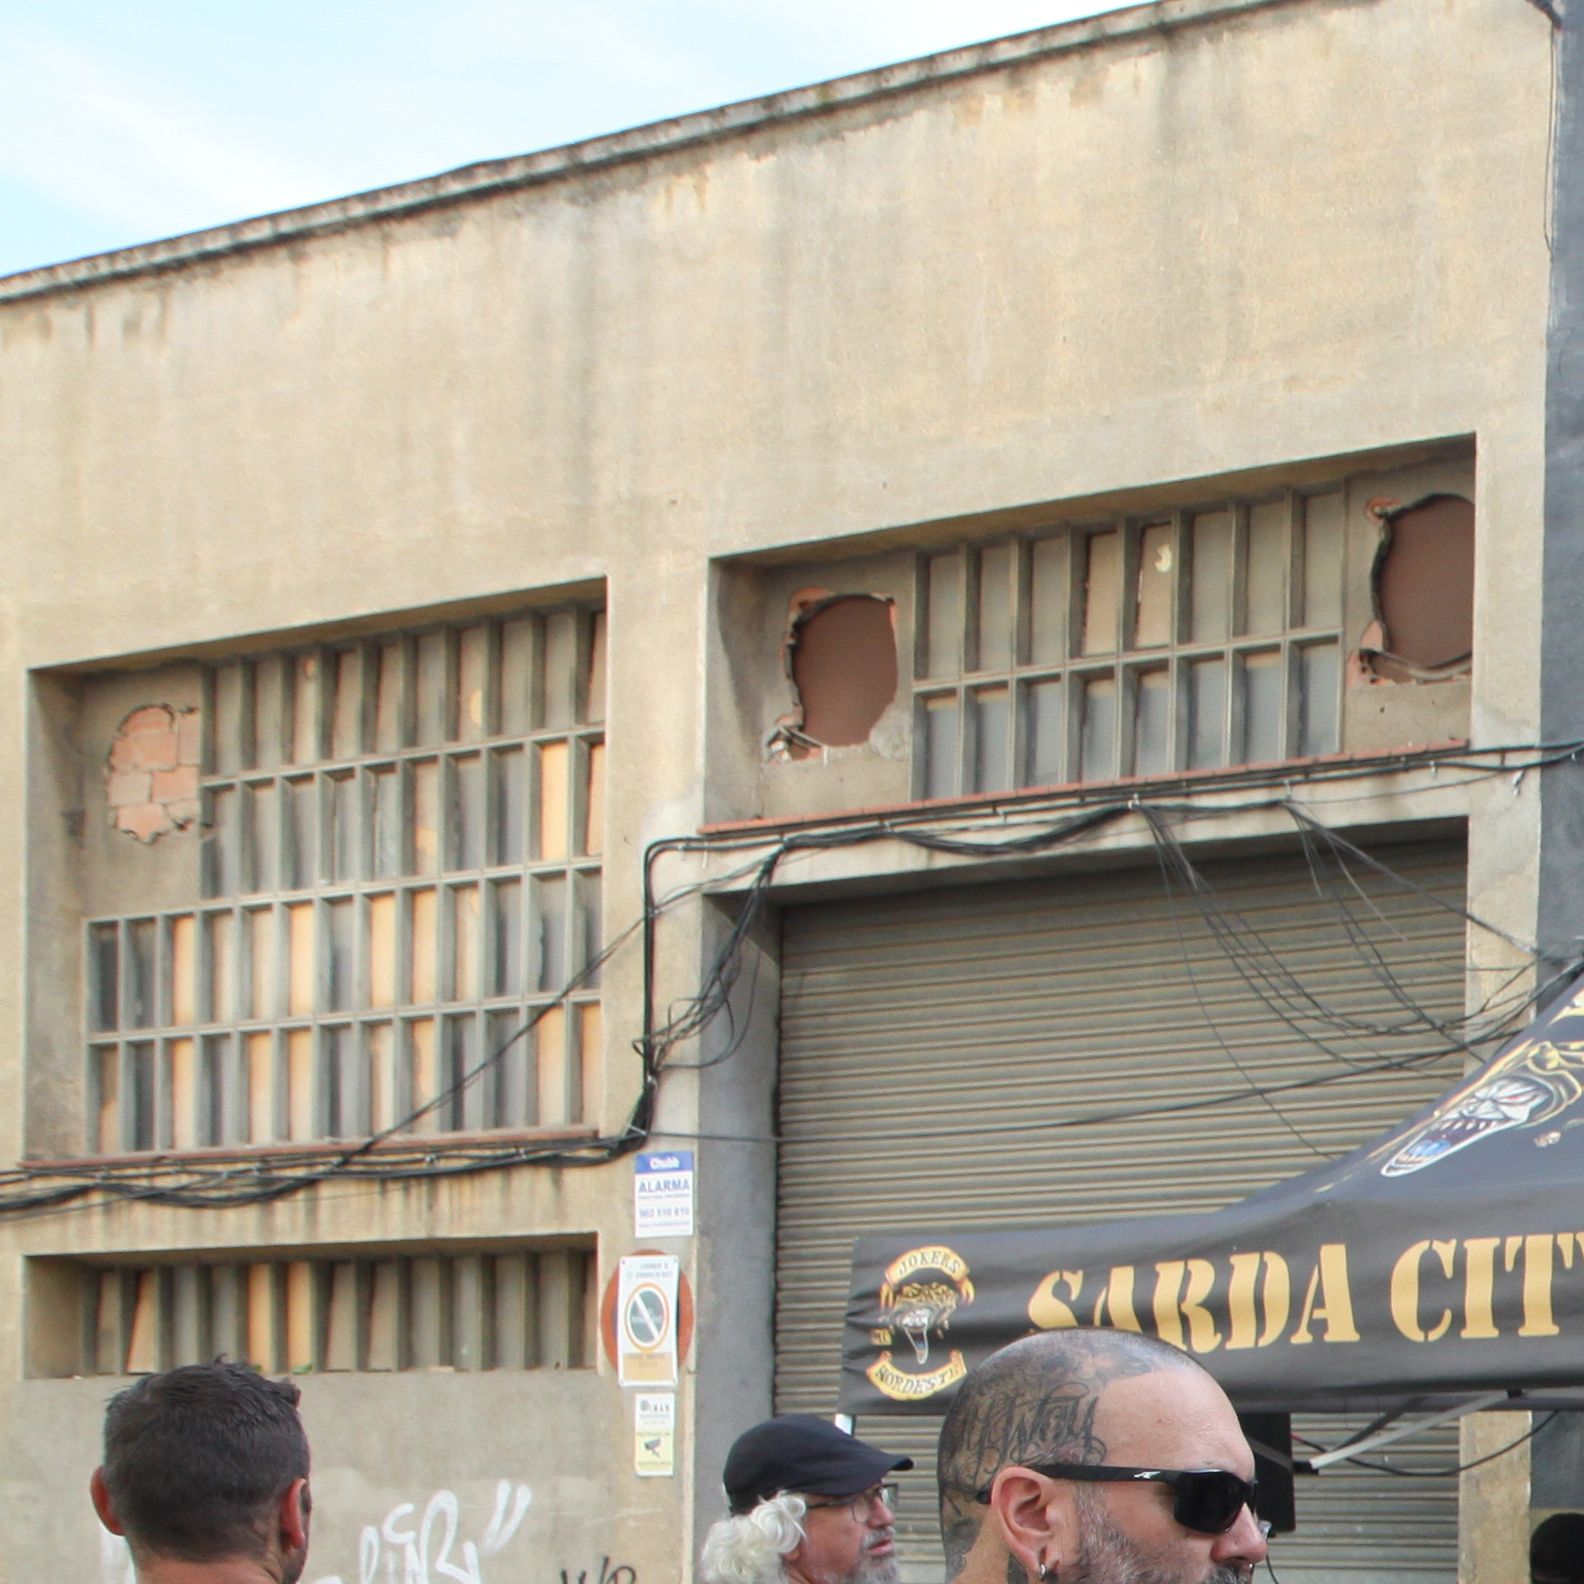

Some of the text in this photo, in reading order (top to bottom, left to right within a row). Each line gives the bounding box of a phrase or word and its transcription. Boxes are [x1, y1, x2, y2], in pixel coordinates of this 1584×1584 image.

[638, 1178, 691, 1194] ALARMA
[899, 1251, 962, 1276] JOKERS
[1028, 1241, 1361, 1353] SARDA
